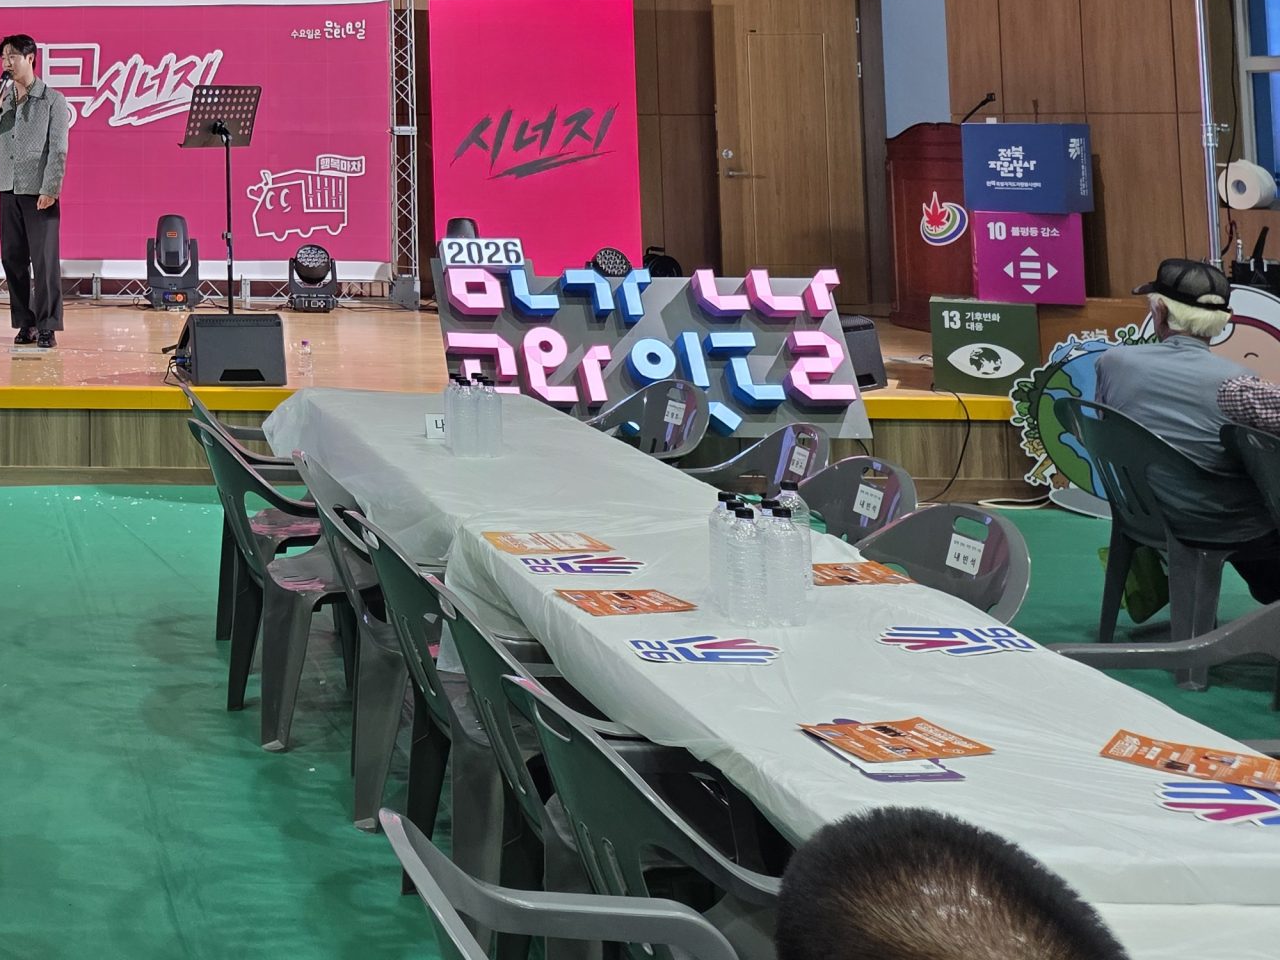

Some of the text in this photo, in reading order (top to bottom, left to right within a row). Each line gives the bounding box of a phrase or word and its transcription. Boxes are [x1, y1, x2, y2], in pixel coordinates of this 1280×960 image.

[290, 28, 321, 39] 수요일은
[84, 50, 223, 112] 시너지
[450, 103, 619, 177] 시너지
[998, 146, 1024, 161] 전북
[988, 160, 1036, 178] 자원봉사
[987, 222, 1006, 240] 10
[1011, 227, 1060, 237] 불평등 감소
[448, 241, 520, 264] 2026
[942, 310, 961, 329] 13
[965, 312, 1001, 323] 기후변화
[953, 551, 976, 568] 내빈석
